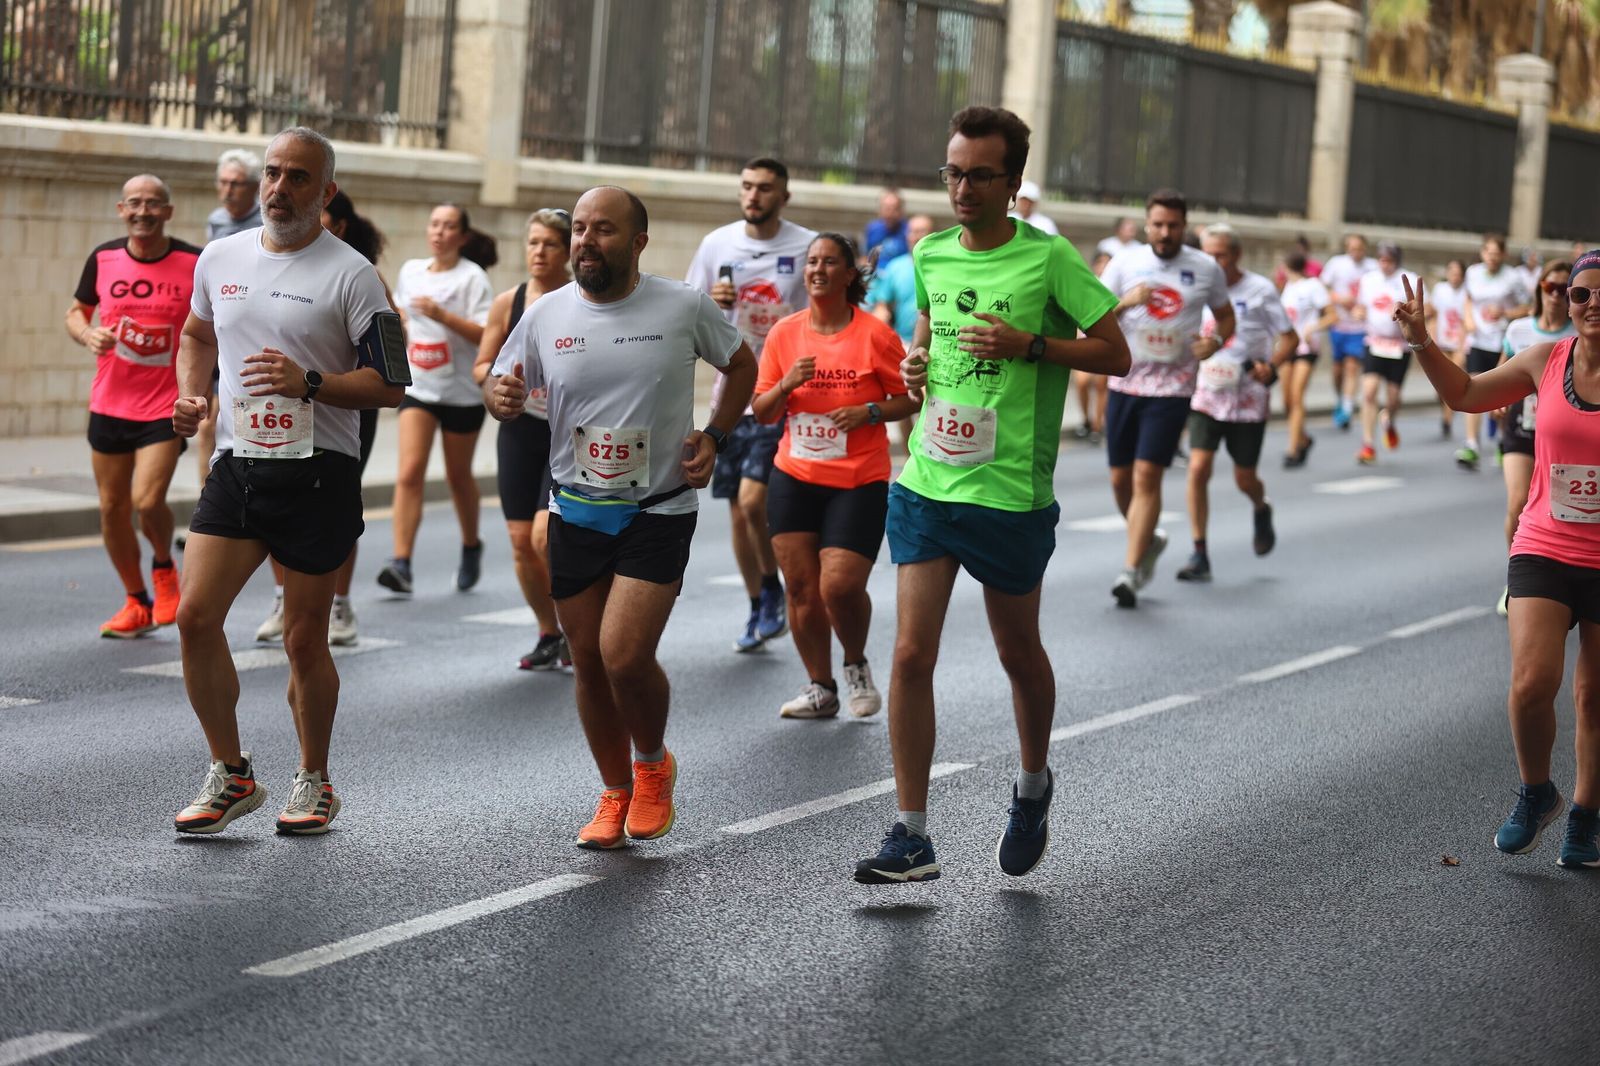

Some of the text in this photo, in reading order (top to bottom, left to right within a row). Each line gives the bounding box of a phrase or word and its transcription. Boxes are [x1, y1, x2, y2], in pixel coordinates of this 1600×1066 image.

[282, 293, 313, 304] HYUNDAI
[988, 295, 1012, 313] AXA
[628, 334, 663, 342] HYUNDAI
[250, 413, 293, 429] 166
[936, 416, 975, 439] 120
[797, 424, 838, 438] 1130
[589, 442, 630, 460] 675
[1569, 480, 1600, 495] 23
